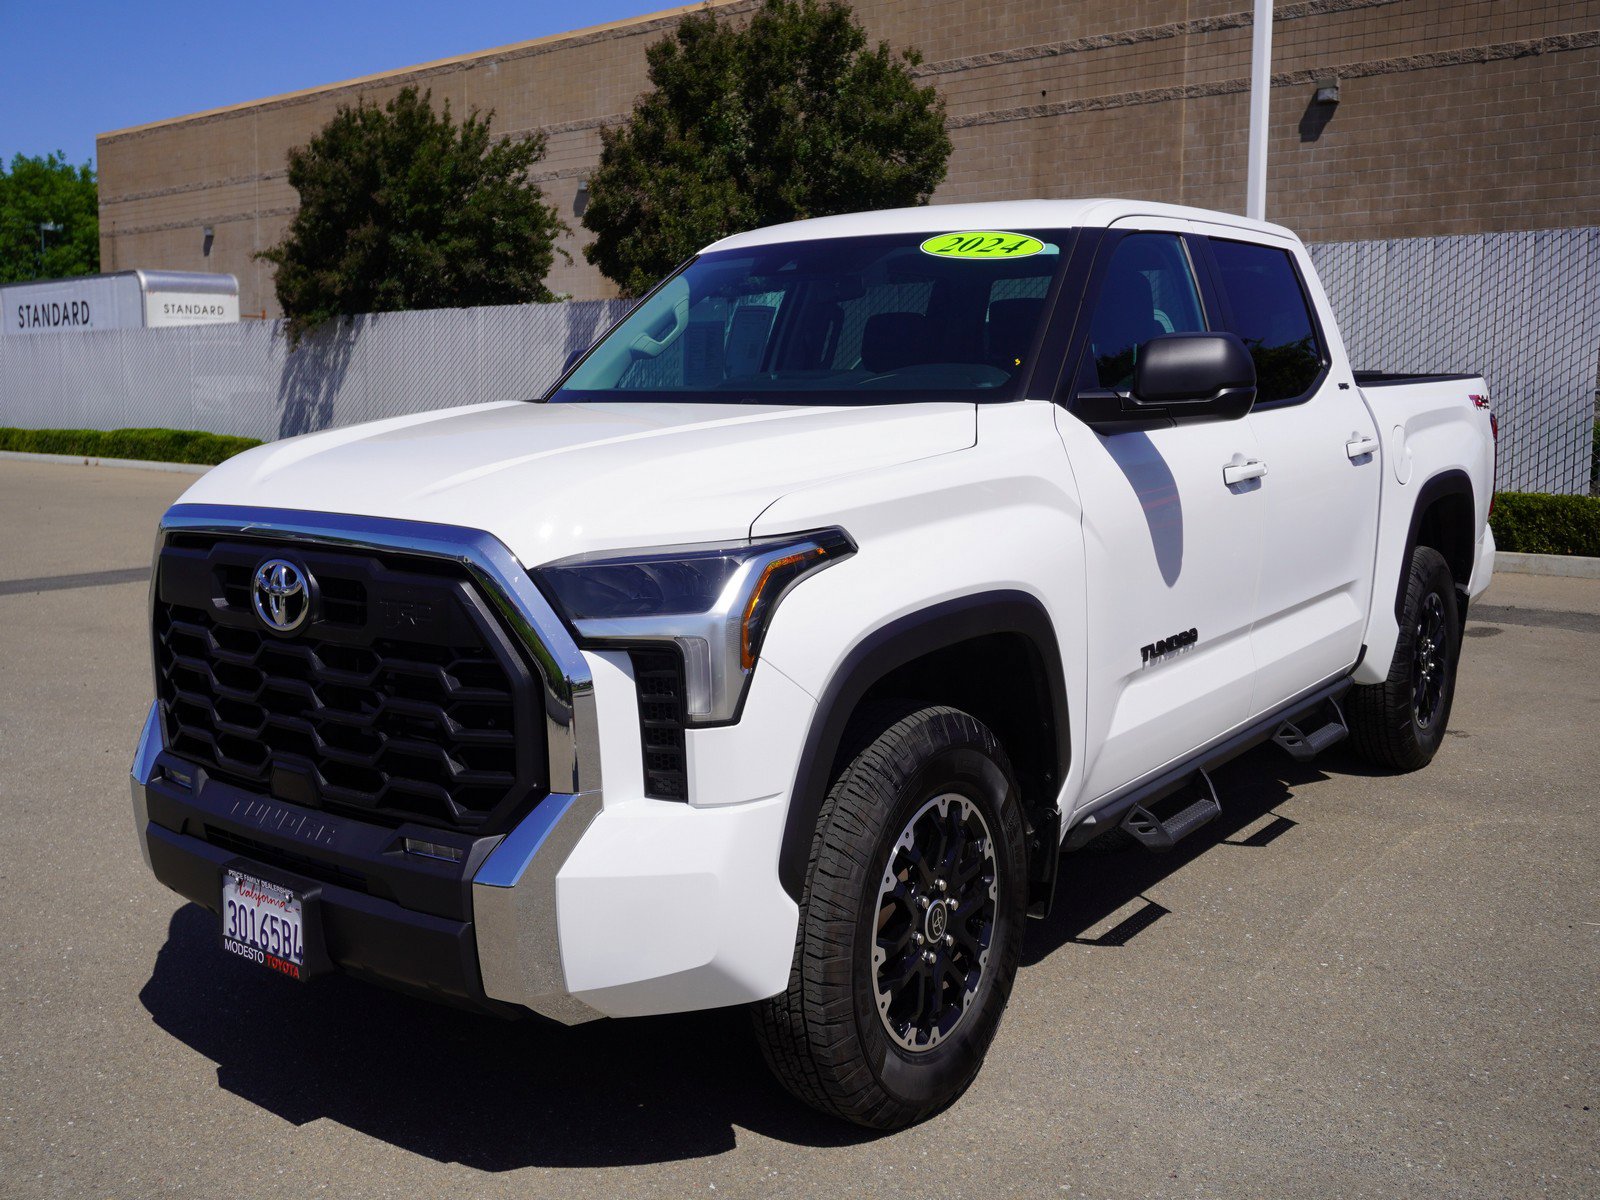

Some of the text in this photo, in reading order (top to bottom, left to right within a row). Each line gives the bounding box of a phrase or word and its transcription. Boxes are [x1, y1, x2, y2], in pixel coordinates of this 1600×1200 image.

[935, 236, 1030, 254] 2024
[18, 300, 90, 329] STANDARD
[163, 303, 225, 316] STANDARD
[239, 880, 289, 910] California
[224, 938, 300, 979] MODESTO TOYOTA
